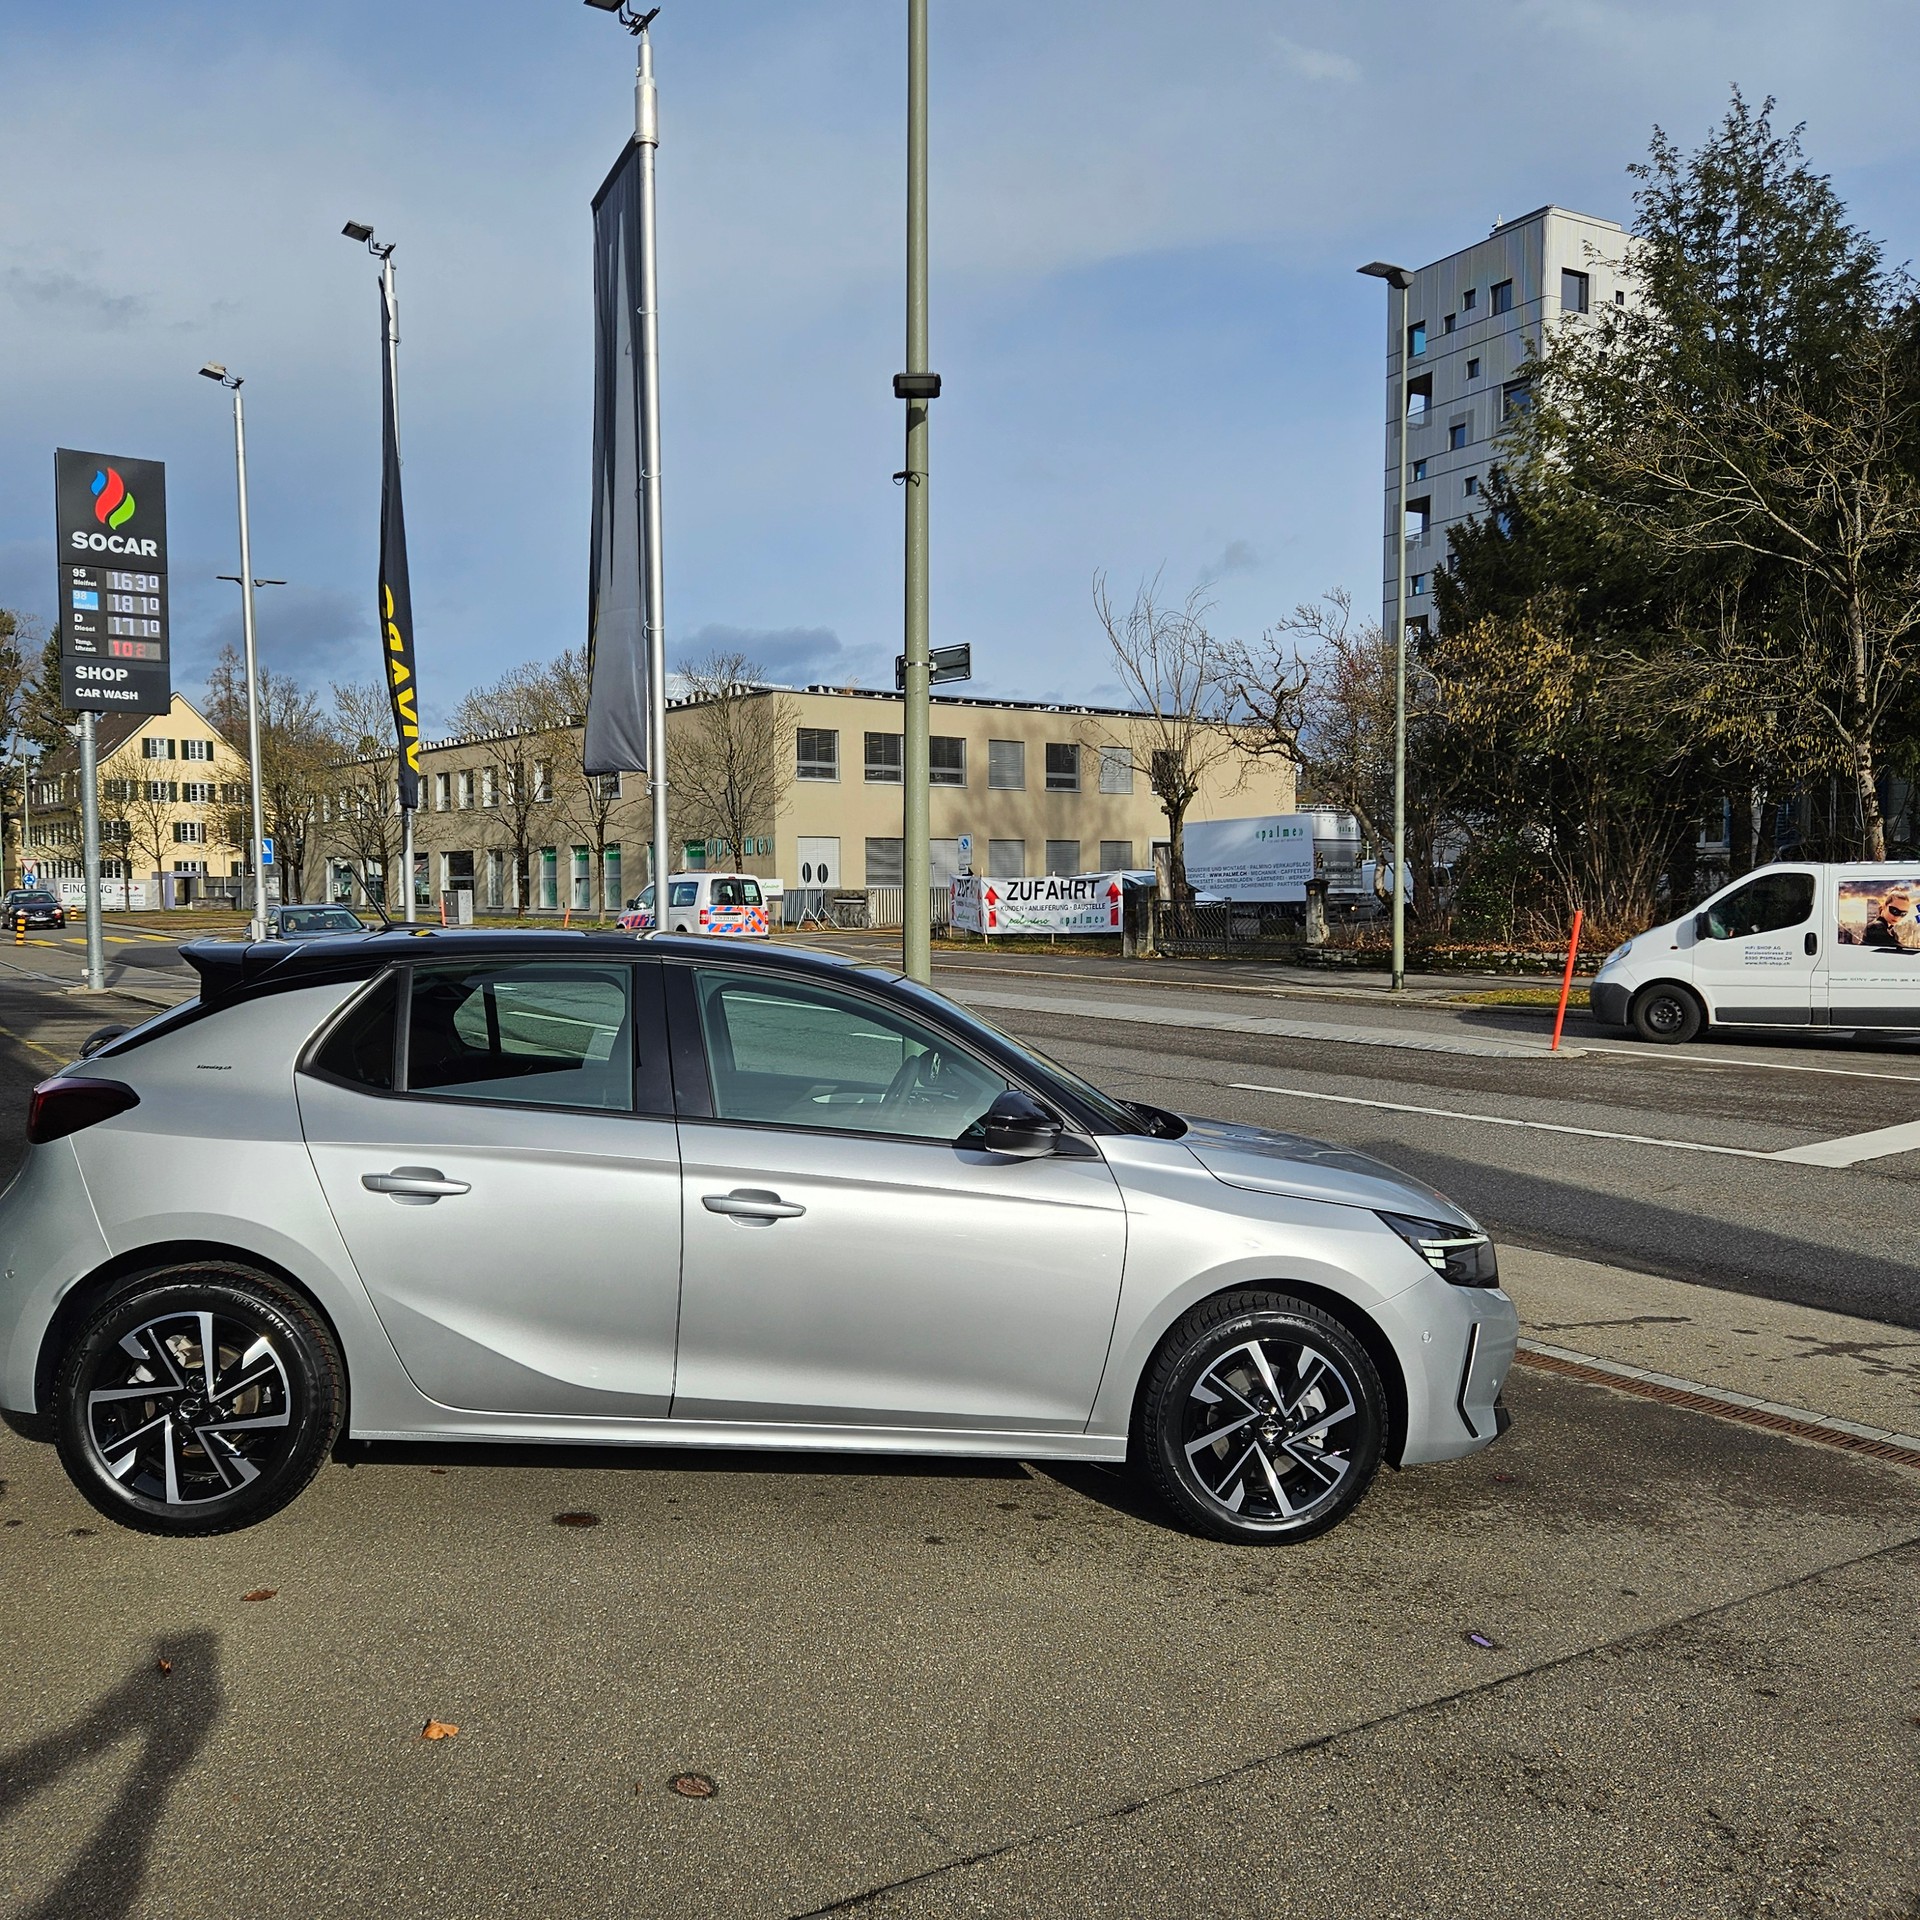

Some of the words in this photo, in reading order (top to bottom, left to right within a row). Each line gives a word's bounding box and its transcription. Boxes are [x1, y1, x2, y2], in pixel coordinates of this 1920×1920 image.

[71, 531, 157, 557] SOCAR
[72, 568, 86, 578] 95
[73, 590, 87, 600] 98
[74, 613, 84, 622] D
[74, 624, 96, 632] Diesel
[75, 666, 128, 682] SHOP
[75, 688, 101, 698] CAR
[102, 689, 139, 700] WASH
[1006, 880, 1100, 901] ZUFAHRT
